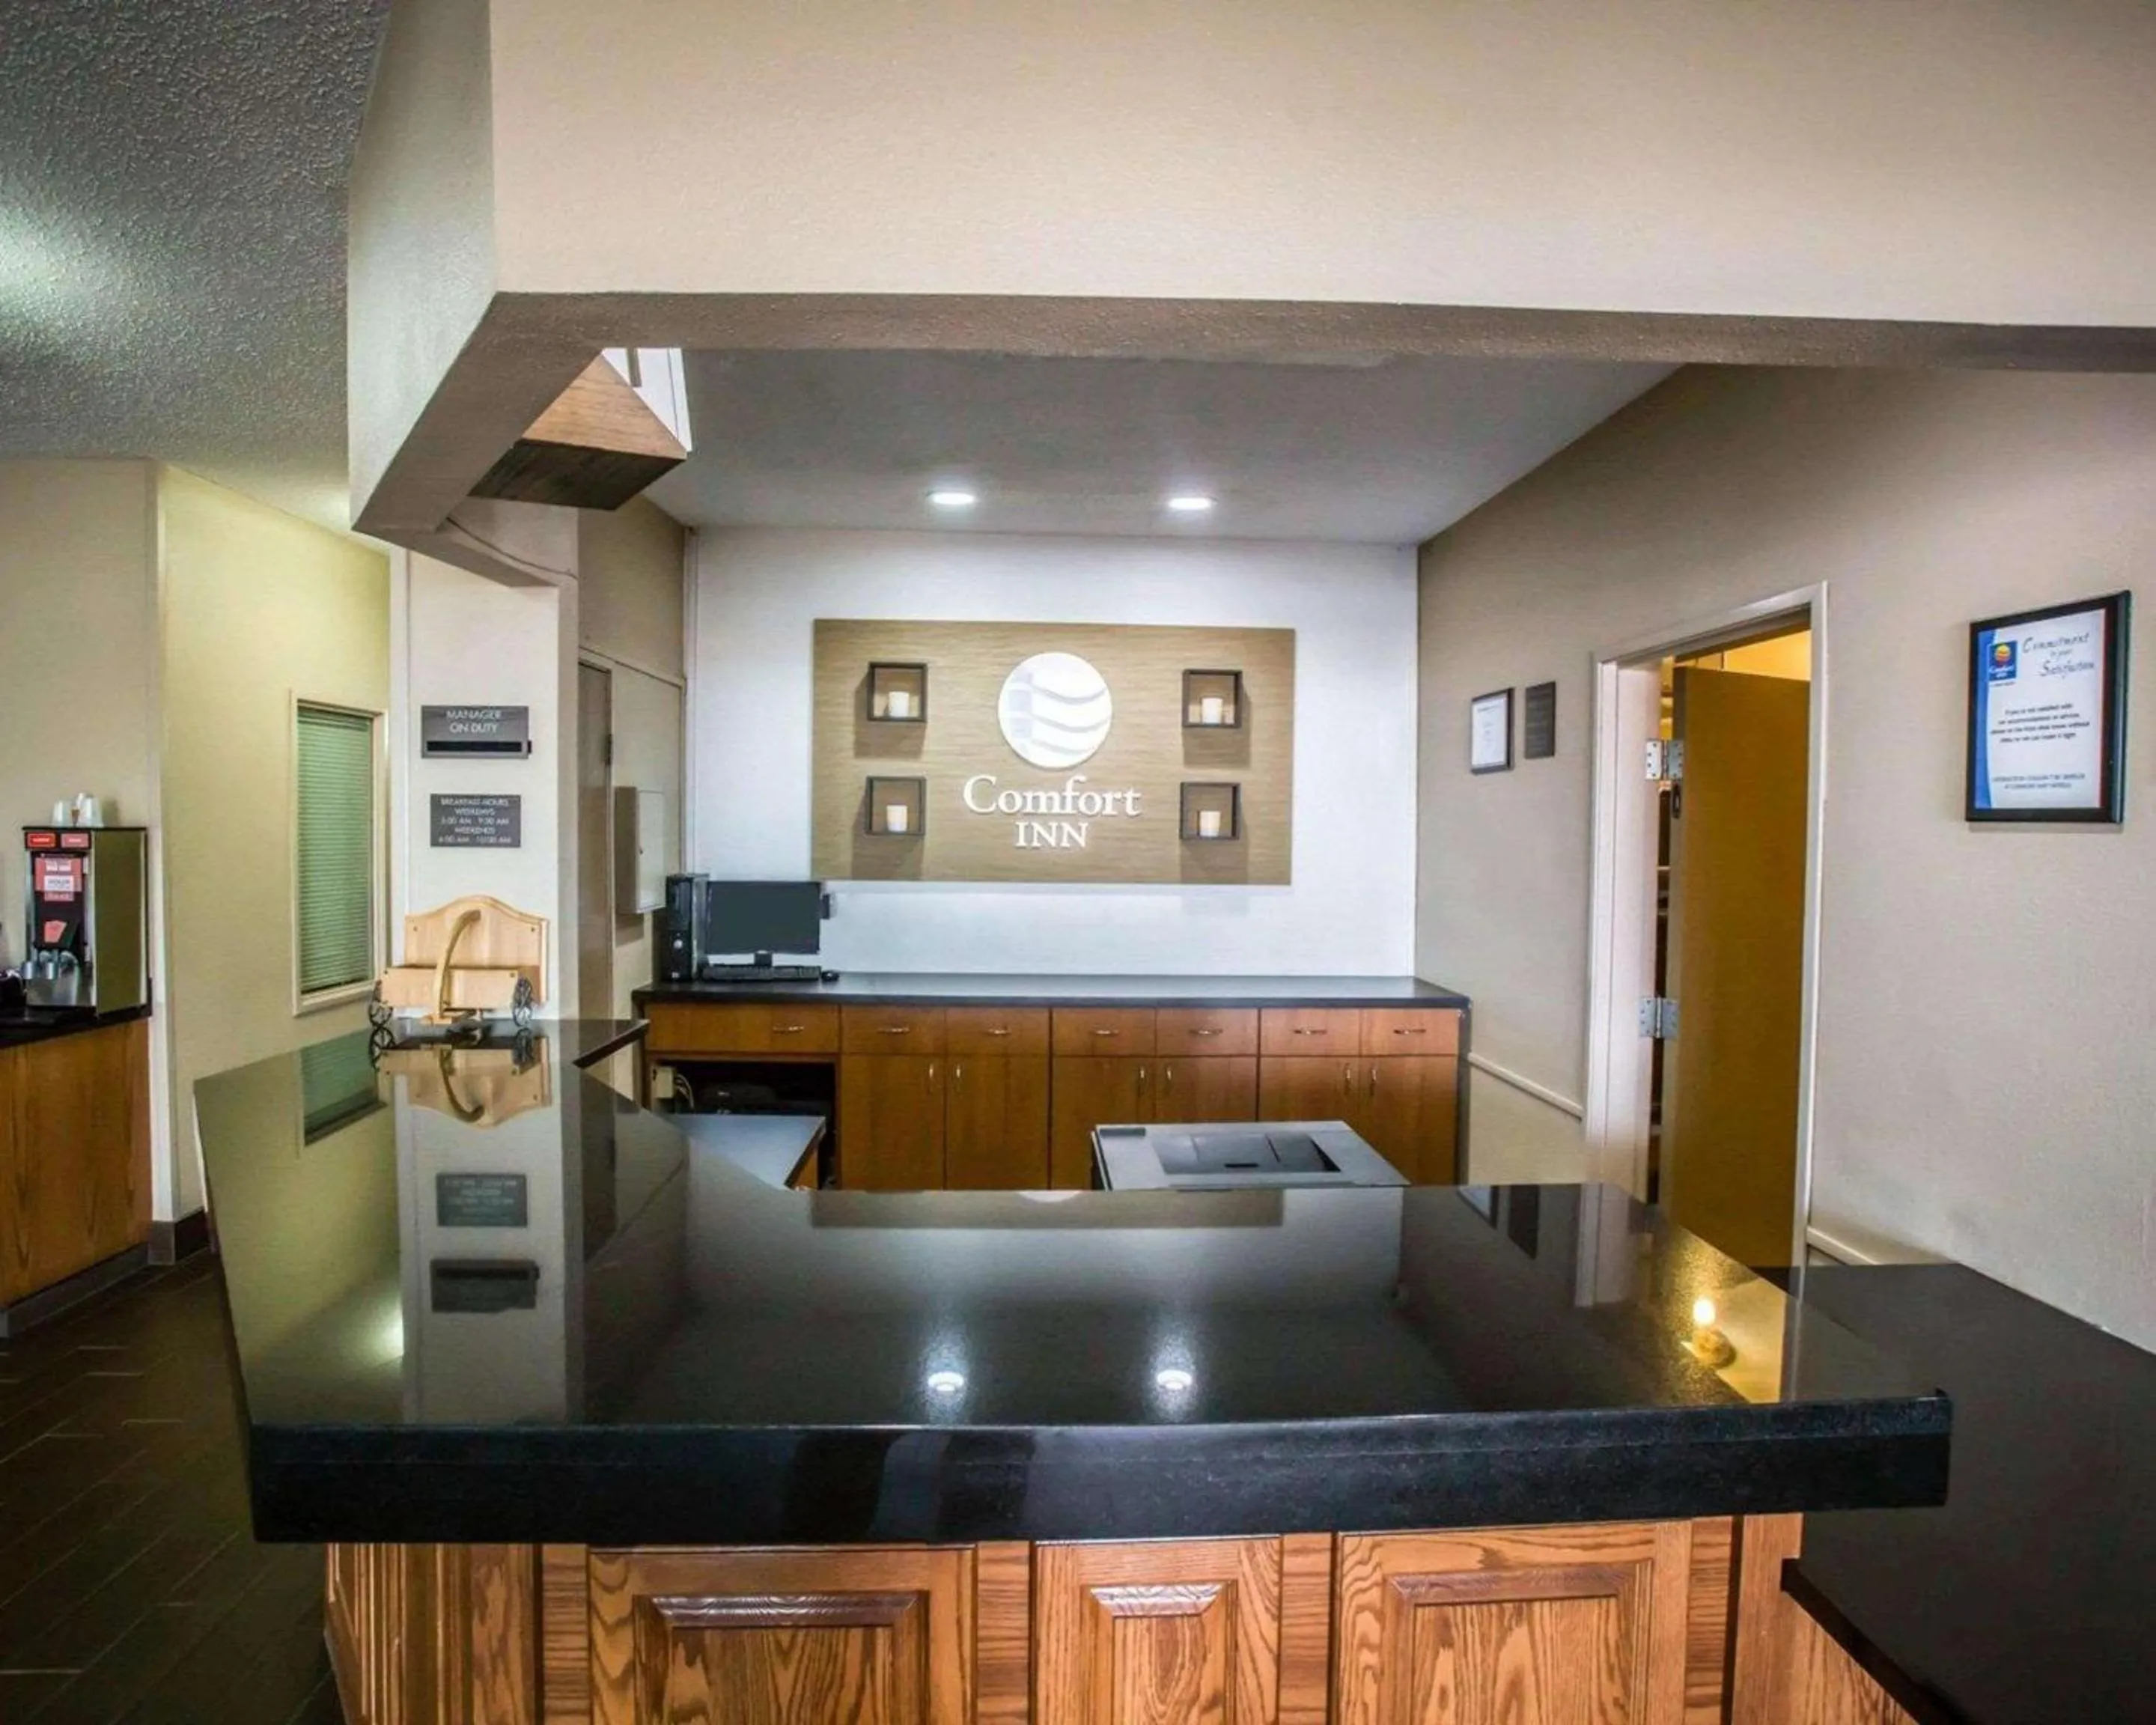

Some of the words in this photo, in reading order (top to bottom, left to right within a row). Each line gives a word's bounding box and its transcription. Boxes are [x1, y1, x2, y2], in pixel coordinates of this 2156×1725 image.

[447, 710, 502, 719] MANAGER
[450, 722, 469, 733] ON
[470, 722, 499, 733] DUTY
[963, 774, 1142, 817] Comfort
[1015, 821, 1088, 848] INN
